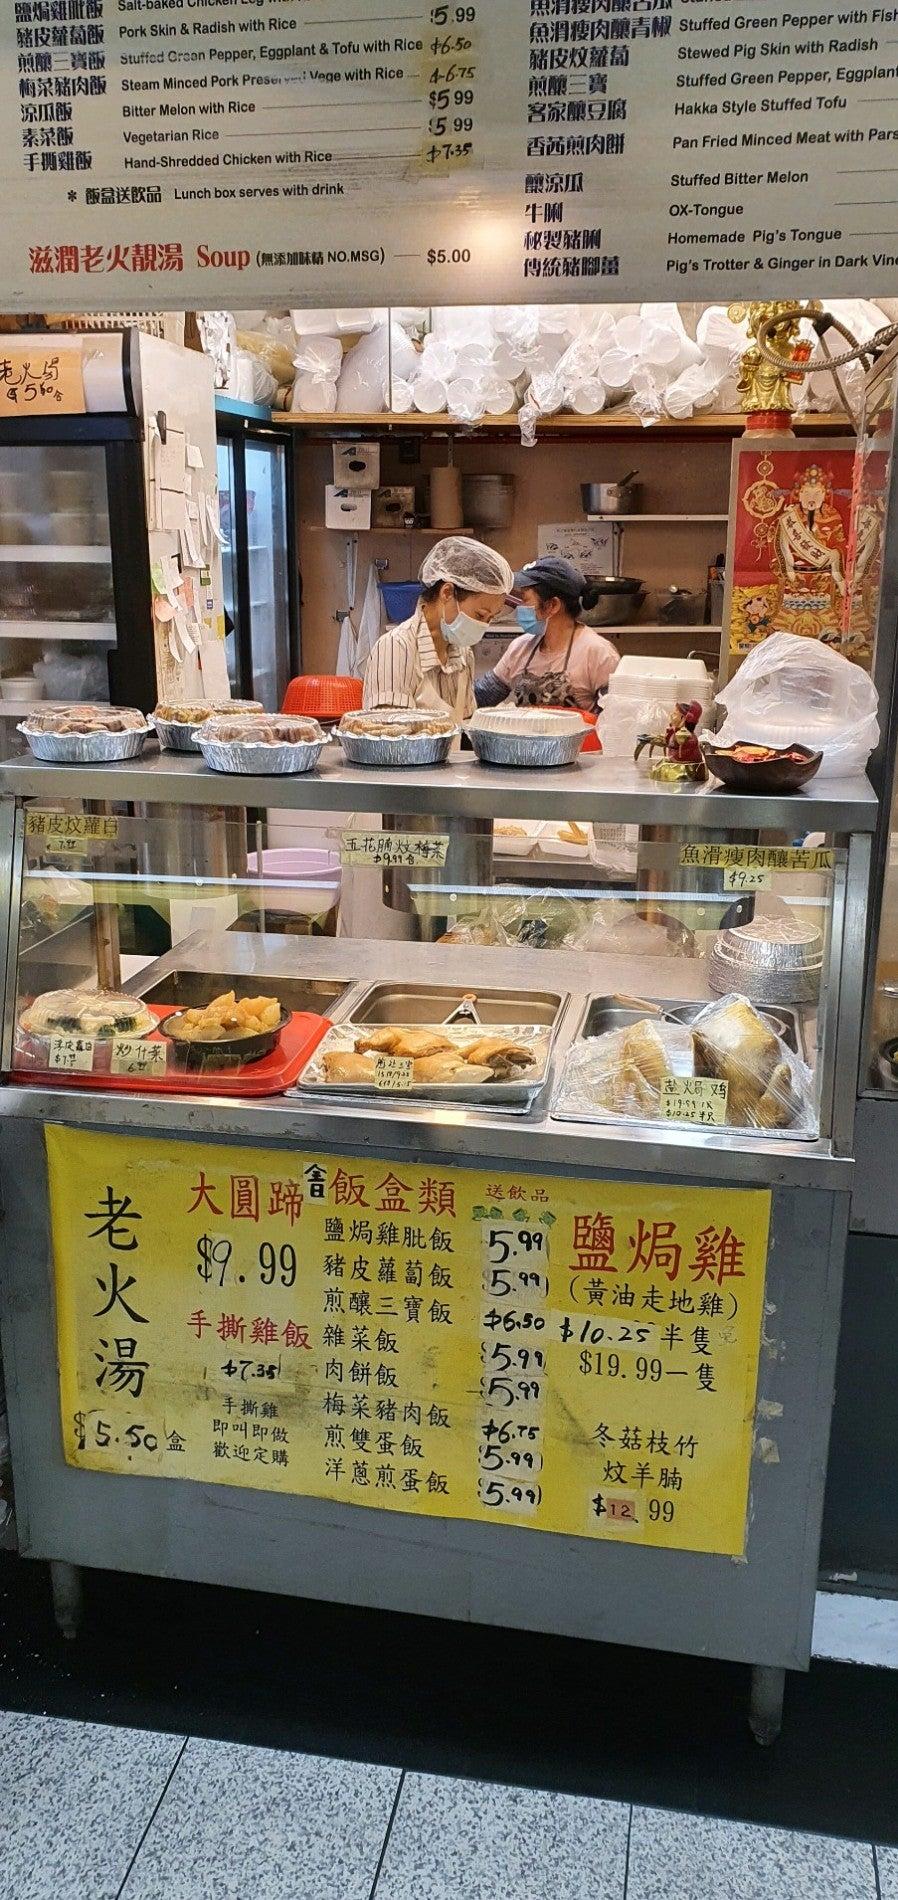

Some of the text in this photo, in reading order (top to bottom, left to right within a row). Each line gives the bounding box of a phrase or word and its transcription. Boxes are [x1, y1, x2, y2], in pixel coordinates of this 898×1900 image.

[119, 17, 297, 38] Pork Skin & Radish with Rice
[529, 15, 672, 44] 魚滑瘦肉釀青椒
[679, 17, 730, 32] Stuffed
[735, 15, 777, 29] Green
[782, 13, 834, 29] Pepper
[838, 10, 868, 24] with
[120, 52, 164, 65] Stuffed
[209, 47, 256, 62] Pepper,
[260, 43, 316, 60] Eggplant
[320, 43, 328, 54] &
[332, 41, 359, 54] Tofu
[364, 40, 389, 52] with
[395, 38, 423, 50] Rice
[431, 36, 472, 55] $6.50
[678, 38, 878, 60] Stewed Pig Skin with Radish
[121, 79, 160, 91] Steam
[163, 76, 207, 90] Minced
[211, 75, 239, 87] Pork
[344, 69, 371, 81] with
[375, 67, 404, 79] Rice
[677, 74, 726, 87] Stuffed
[731, 72, 773, 85] Green
[778, 70, 831, 85] Pepper,
[21, 102, 72, 122] 涼瓜飯
[122, 101, 256, 118] Bitter Melon with Rice
[527, 98, 627, 123] 客家釀豆腐
[675, 96, 847, 116] Hakka Style Stuffed Tofu
[22, 127, 73, 147] 素菜飯
[123, 129, 219, 145] Vegetarian Rice
[527, 133, 625, 156] 香茜煎肉餅
[673, 136, 698, 149] Pan
[702, 135, 738, 147] Fried
[742, 132, 792, 146] Minced
[796, 131, 831, 144] Meat
[834, 129, 864, 142] with
[23, 151, 93, 171] 手撕雞飯
[124, 151, 333, 169] Hand-Shredded Chicken with Rice
[525, 172, 584, 194] 釀涼瓜
[671, 171, 809, 186] Stuffed Bitter Melon
[85, 186, 162, 204] 飯盒送飲品
[174, 183, 344, 200] Lunch box serves with drink
[669, 204, 744, 219] OX-Tongue
[667, 229, 842, 245] Homemade Pig's Tongue
[29, 243, 184, 274] 滋潤老火靚湯
[197, 244, 250, 270] Soup
[427, 249, 471, 264] $5.00
[666, 260, 699, 275] Pig's
[703, 259, 750, 271] Trotter
[754, 258, 764, 270] &
[767, 257, 815, 272] Ginger
[819, 256, 831, 268] in
[835, 255, 868, 267] Dark
[681, 844, 831, 869] 魚滑瘦肉釀苦瓜
[729, 870, 764, 887] $9.25
[187, 1171, 304, 1227] 大圓蹄
[328, 1168, 457, 1218] 飯盒類
[485, 1184, 549, 1202] 送飲品
[197, 1233, 297, 1287] $9.99
[569, 1211, 746, 1286] 鹽焗雞
[323, 1253, 454, 1289] 豬皮蘿蔔飯
[84, 1186, 150, 1398] 老火湯
[323, 1286, 453, 1325] 煎釀三寶飯
[187, 1309, 313, 1350] 手撕雞飯
[483, 1308, 545, 1332] $6.50
[322, 1323, 400, 1354] 雜菜飯
[559, 1316, 650, 1345] $10.25
[660, 1322, 713, 1356] 半隻
[325, 1357, 400, 1388] 肉餅飯
[222, 1396, 279, 1418] 手撕雞
[322, 1391, 452, 1429] 梅菜豬肉飯
[74, 1410, 158, 1452] $5.50
[213, 1418, 289, 1444] 即叫即做
[324, 1423, 425, 1458] 煎雙蛋飯
[592, 1422, 699, 1459] 冬菇枝竹
[212, 1441, 289, 1468] 歡迎定購
[603, 1460, 683, 1491] 炆羊腩
